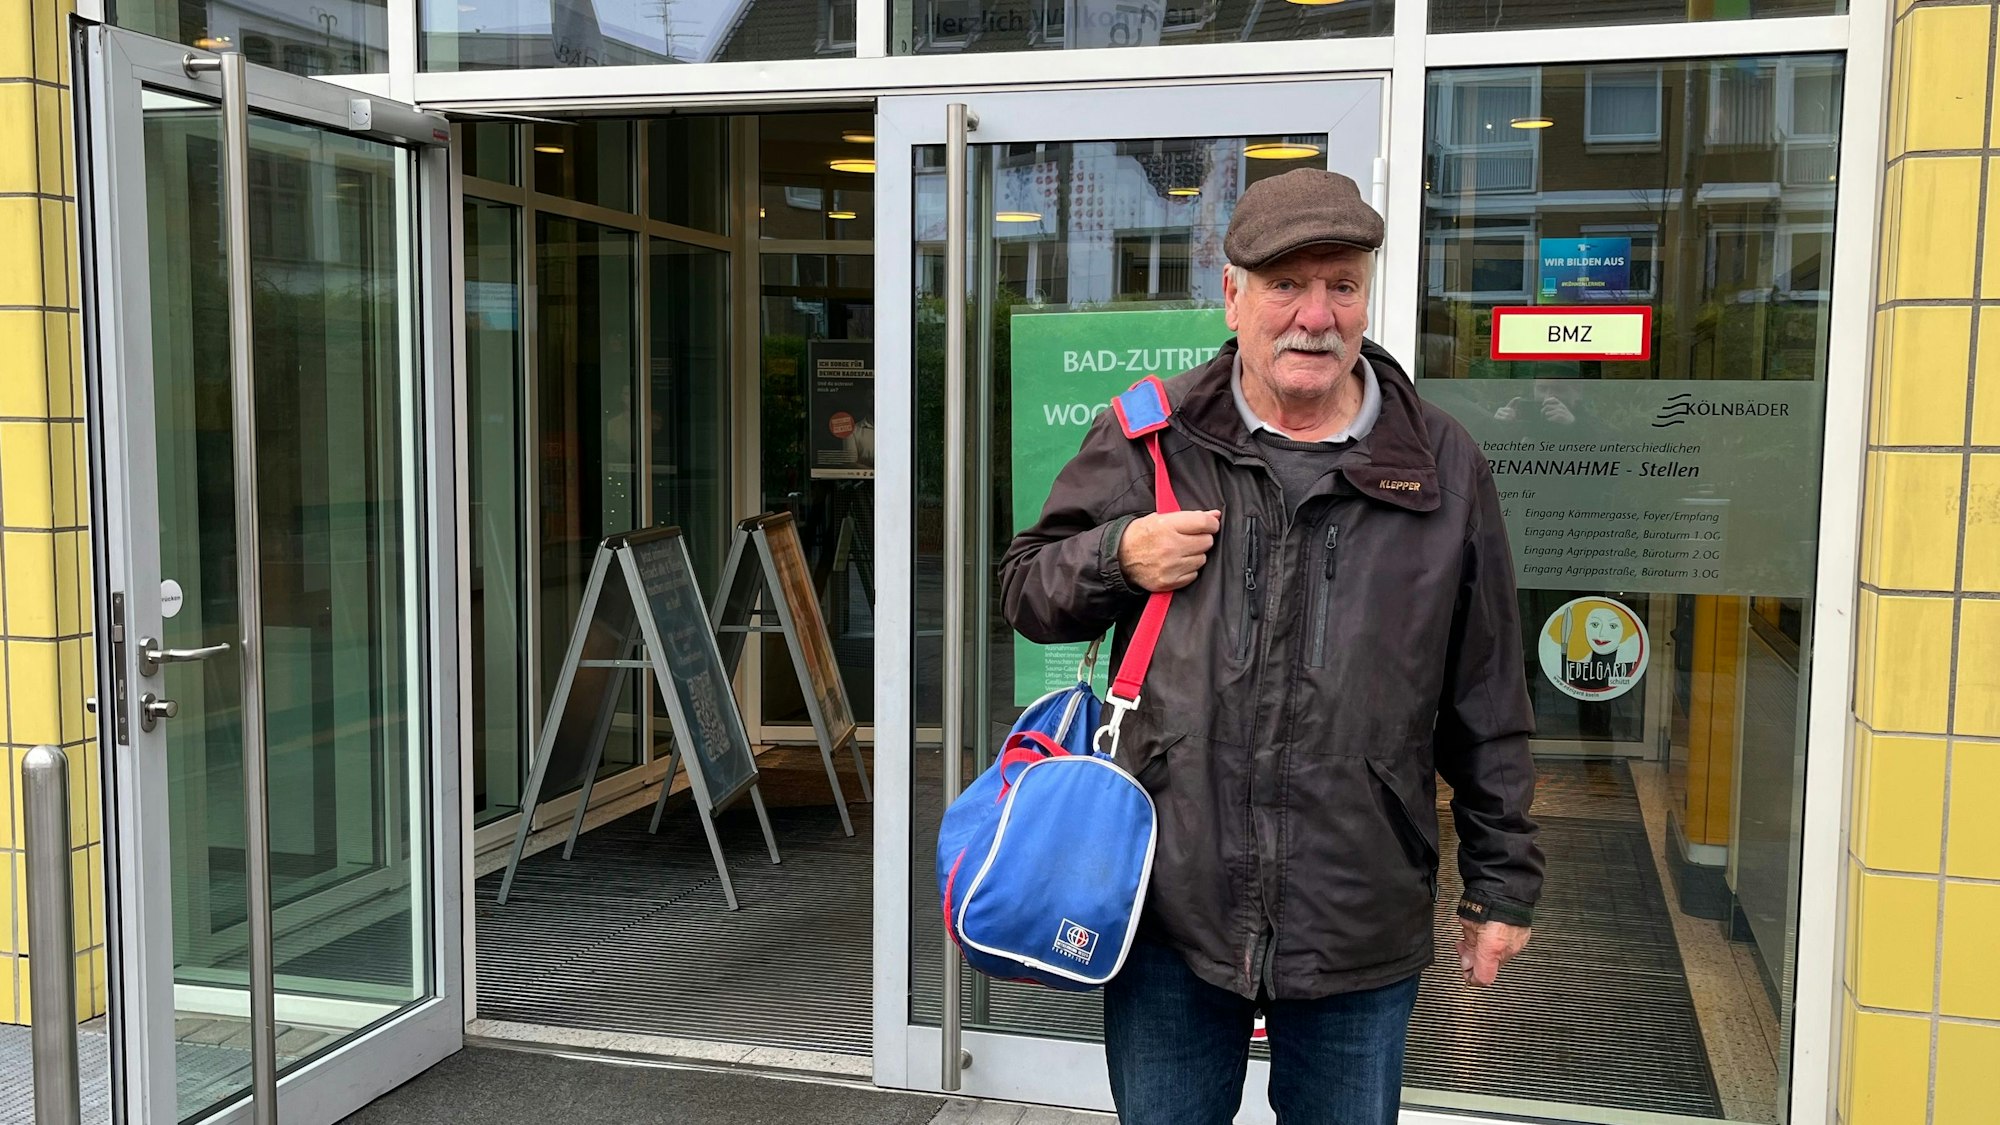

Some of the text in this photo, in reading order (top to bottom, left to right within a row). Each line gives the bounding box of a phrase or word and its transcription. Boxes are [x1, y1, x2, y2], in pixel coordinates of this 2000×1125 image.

[924, 9, 1023, 34] Herzlich
[1544, 257, 1625, 267] WIR BILDEN AUS
[1548, 325, 1593, 343] BMZ
[1063, 347, 1221, 373] BAD-ZUTRIT
[1686, 399, 1790, 417] KÖLNBÄDER
[1483, 441, 1701, 454] beachten Sie unsere unterschiedlichen
[1488, 459, 1621, 477] RENANNAHME
[1639, 461, 1700, 478] Stellen
[1379, 479, 1421, 492] KLEPPER
[1521, 489, 1536, 499] für
[1525, 508, 1565, 520] Eingang
[1643, 510, 1720, 524] Foyer/Empfang
[1524, 527, 1564, 539] Eingang
[1566, 528, 1639, 540] Agrippastraße,
[1523, 545, 1564, 557] Eingang
[1566, 546, 1638, 559] Agrippastraße,
[1642, 548, 1690, 559] Büroturm
[1523, 564, 1563, 577] Eingang
[1565, 565, 1637, 577] Agrippastraße,
[1641, 567, 1689, 578] Büroturm
[1569, 661, 1628, 681] EDELGARD
